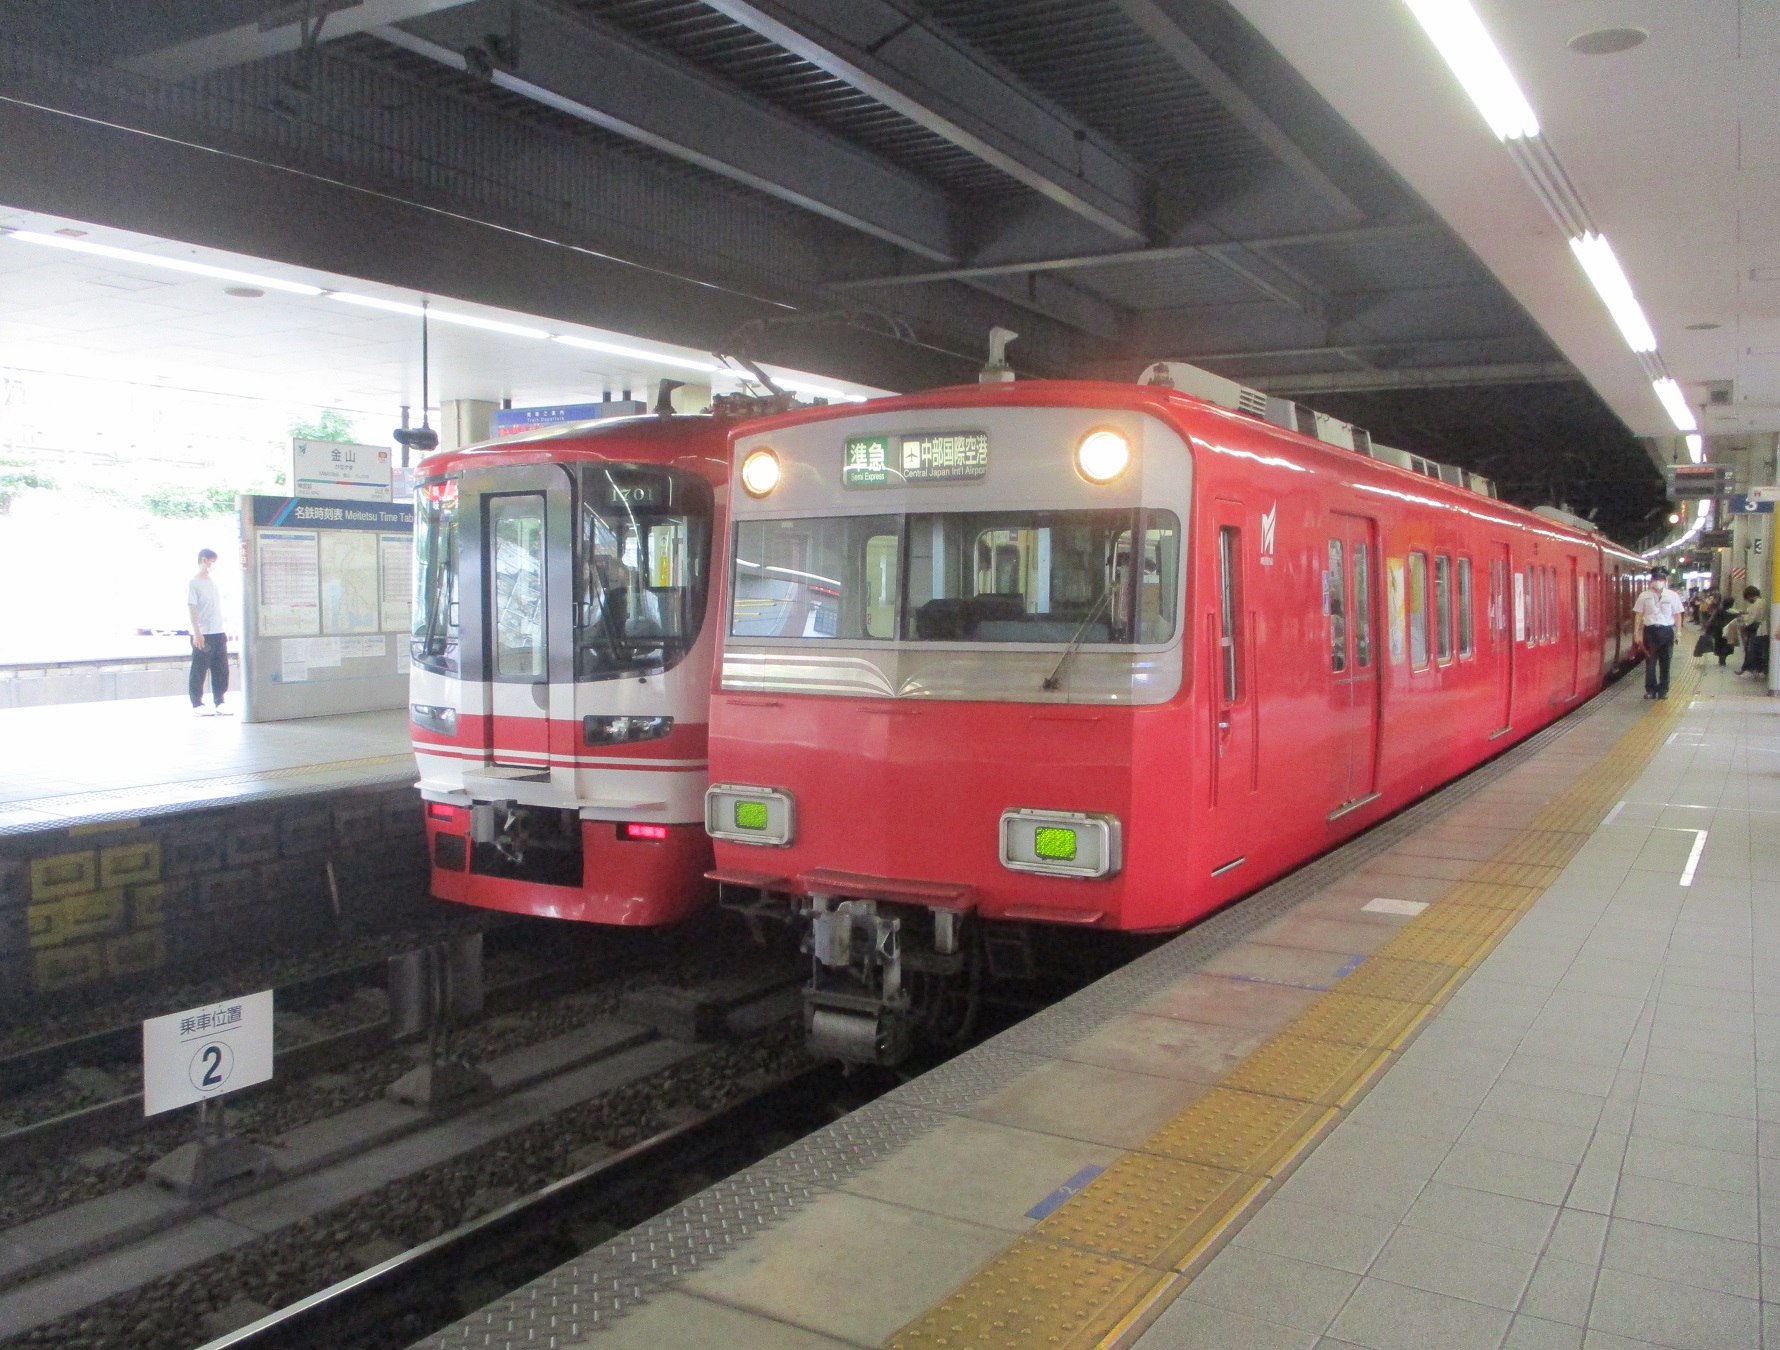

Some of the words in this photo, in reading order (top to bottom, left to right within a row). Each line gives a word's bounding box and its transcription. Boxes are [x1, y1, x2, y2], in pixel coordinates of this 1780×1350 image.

[330, 448, 356, 463] 金山
[850, 442, 885, 472] 準急
[921, 435, 988, 468] 中部国際空港
[851, 473, 864, 481] Semi
[864, 472, 885, 481] Express
[903, 469, 928, 479] Central
[929, 468, 950, 478] Japan
[294, 506, 343, 521] 名鉄時刻表
[379, 511, 398, 522] Time
[399, 512, 414, 523] Tab
[179, 1005, 242, 1036] 乗車位置
[202, 1046, 222, 1087] 2
